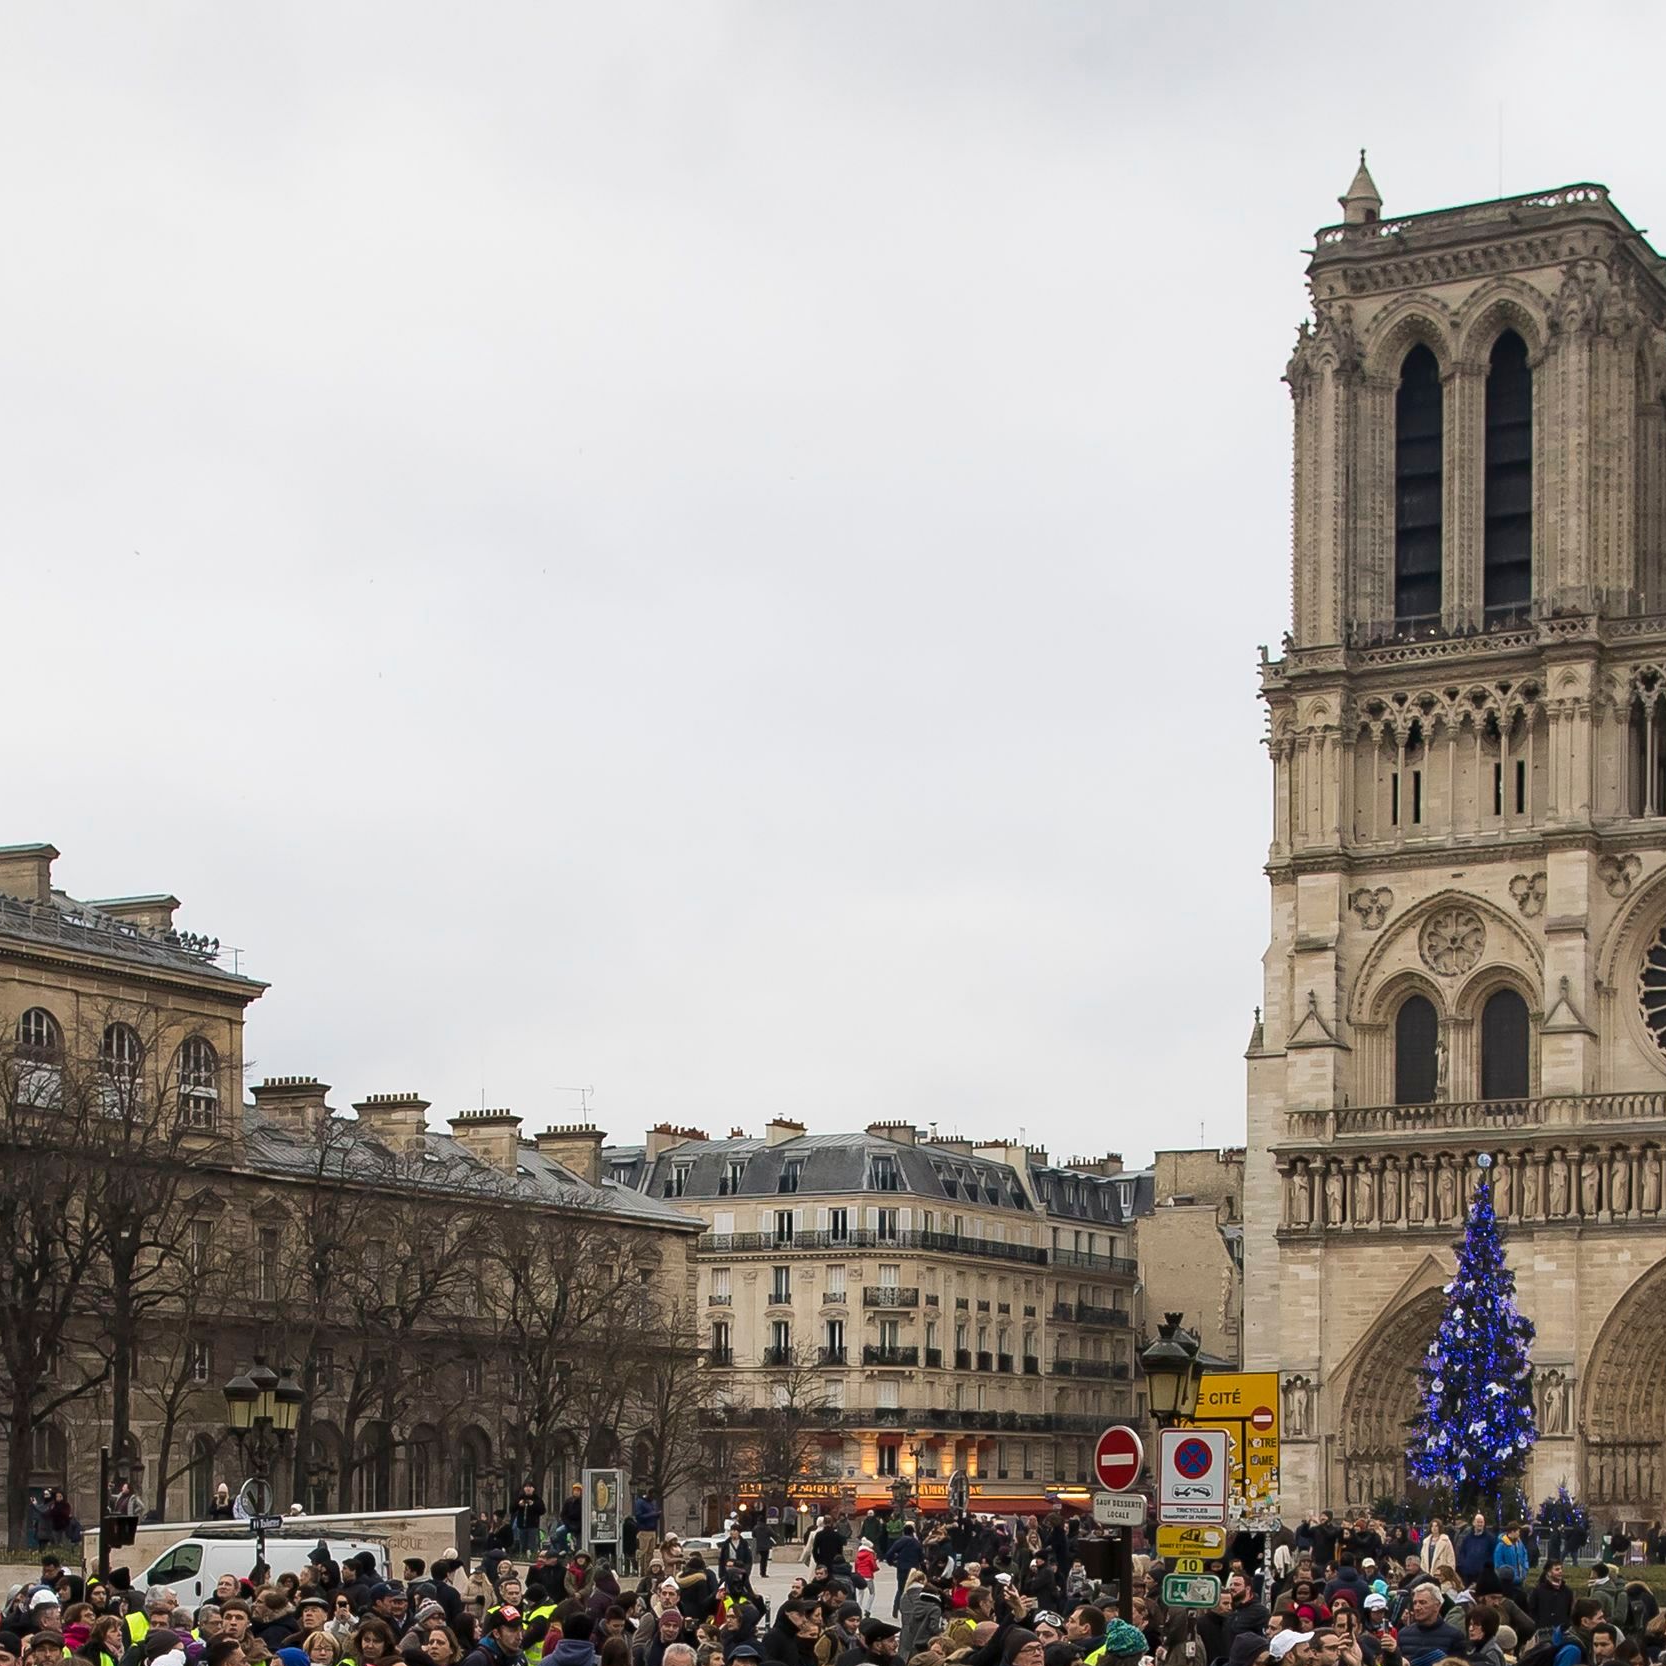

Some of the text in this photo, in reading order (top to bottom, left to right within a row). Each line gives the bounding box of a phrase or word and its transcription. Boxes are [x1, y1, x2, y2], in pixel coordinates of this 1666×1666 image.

[1209, 1389, 1241, 1405] CITÉ
[1248, 1438, 1276, 1447] NTRE
[1096, 1498, 1142, 1509] SAUF DESSERTE
[1107, 1511, 1130, 1519] LOCALE
[1182, 1560, 1197, 1572] 10
